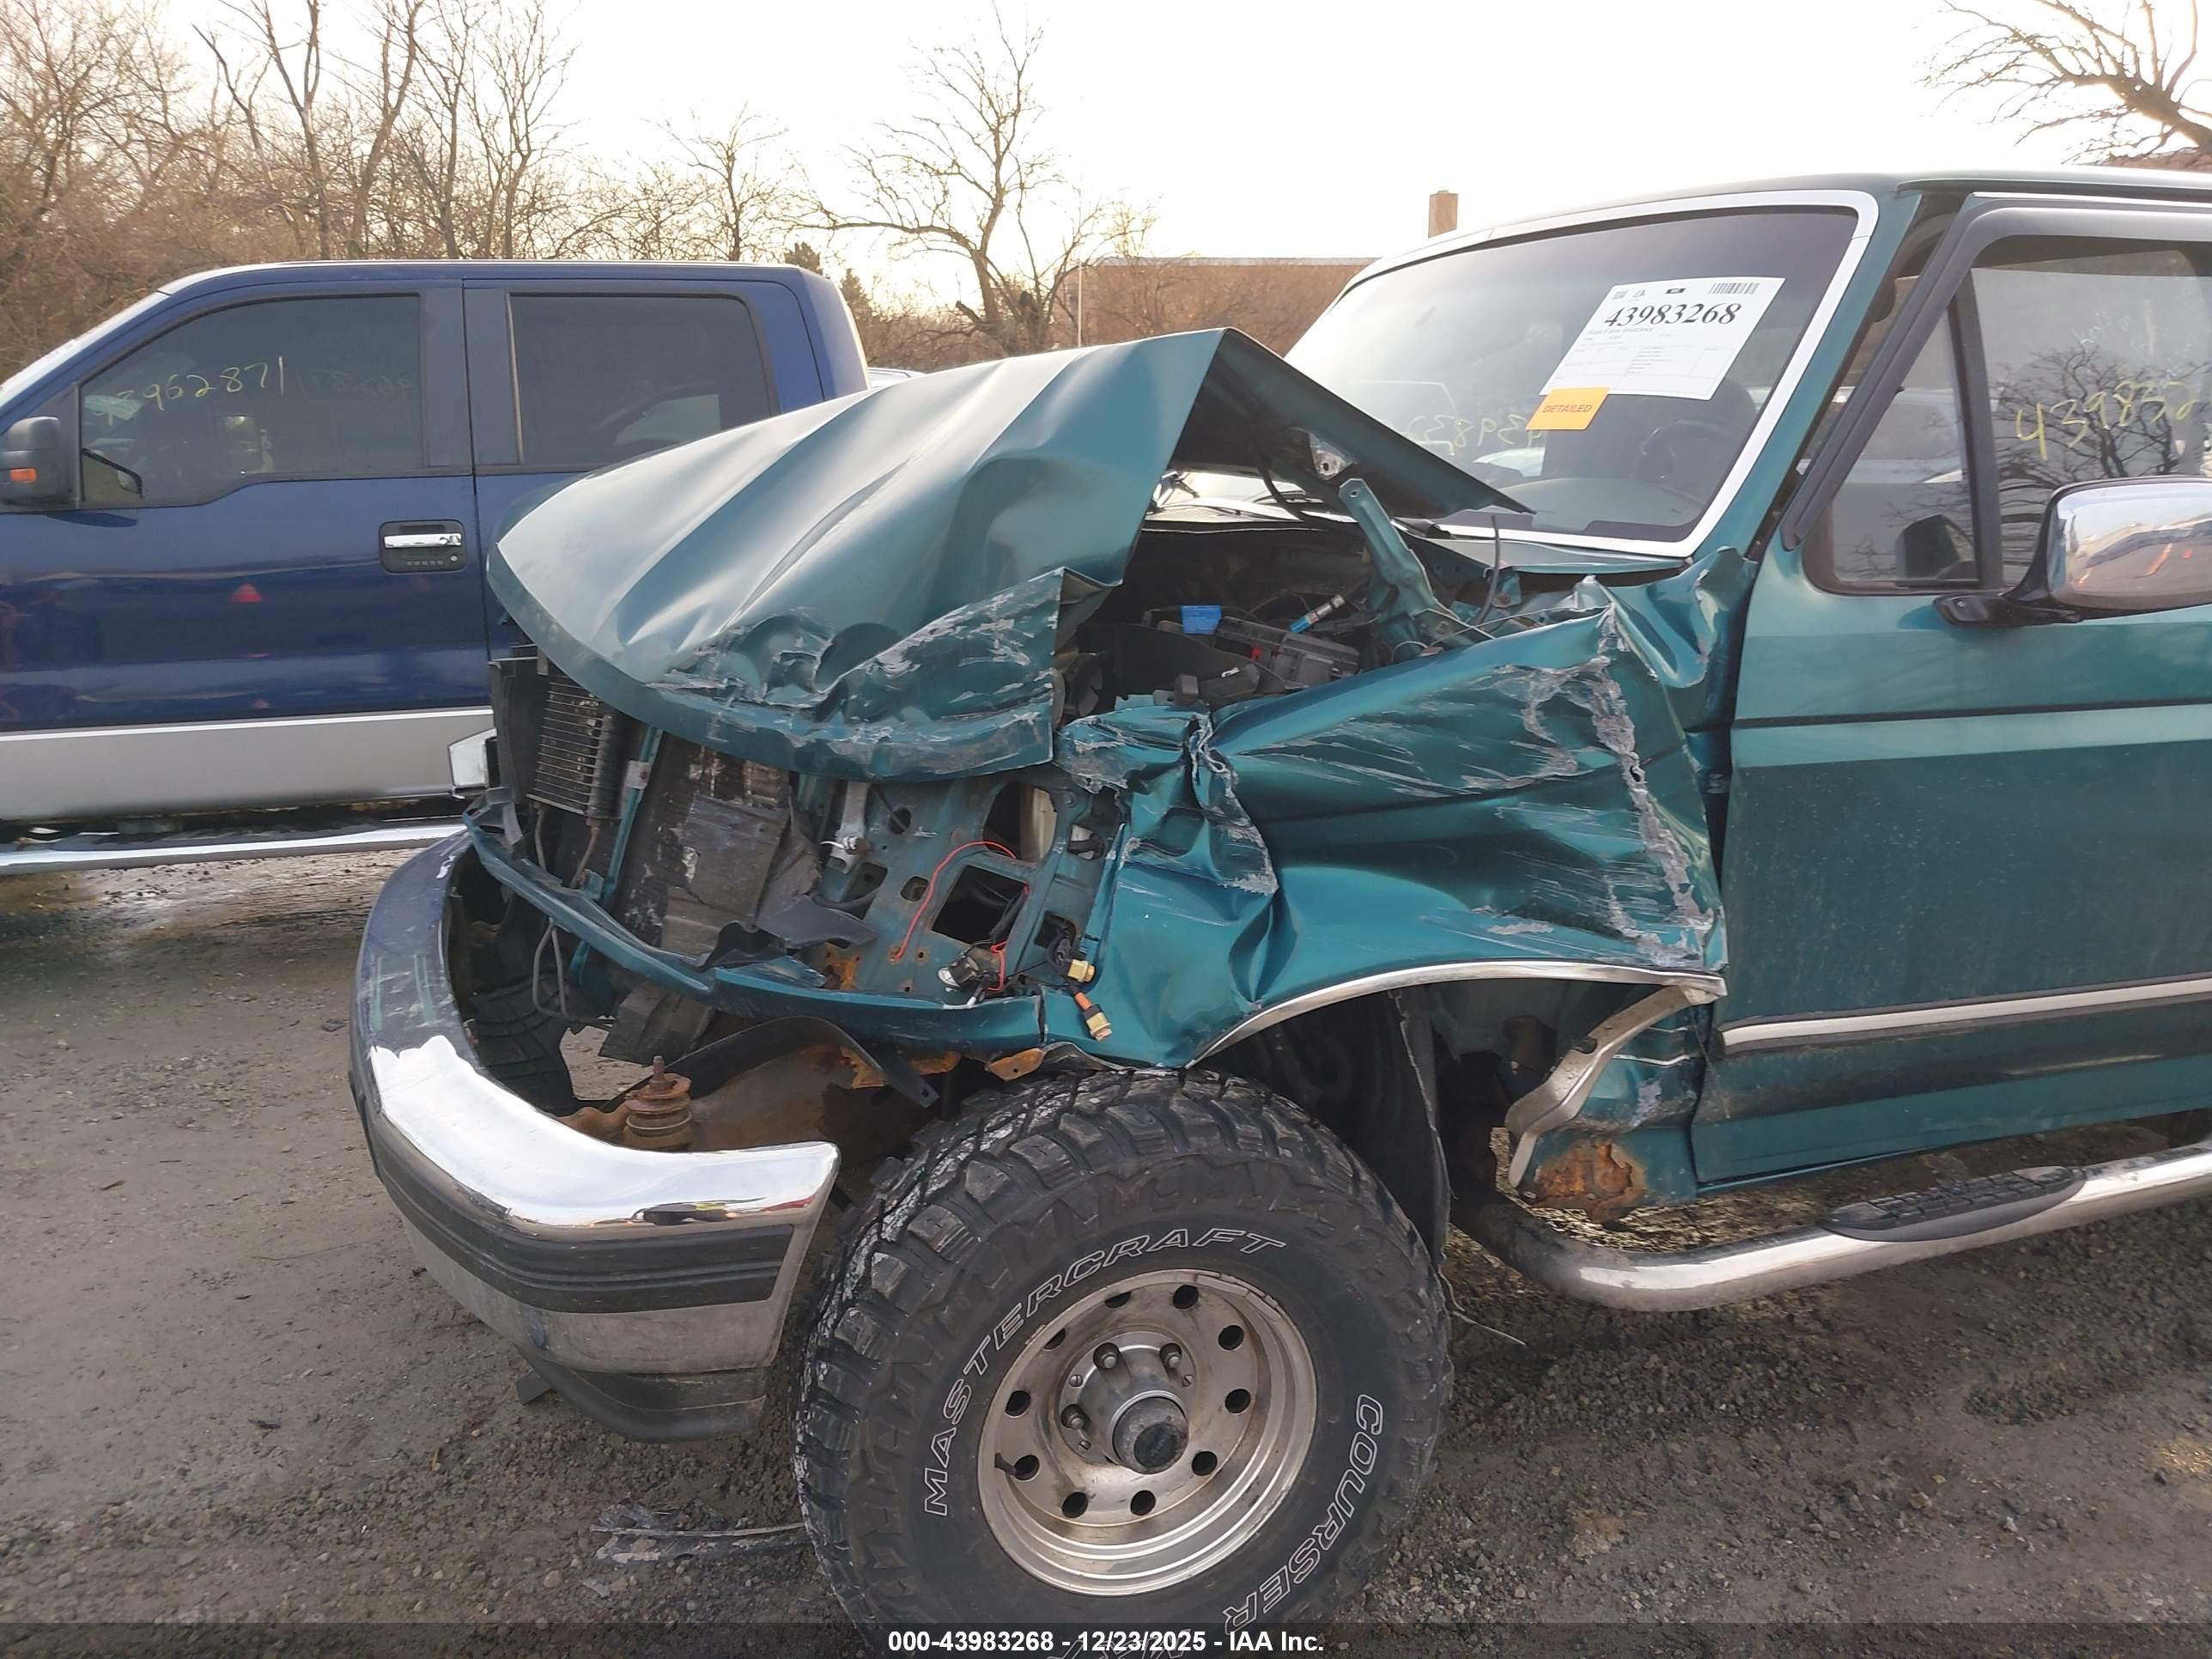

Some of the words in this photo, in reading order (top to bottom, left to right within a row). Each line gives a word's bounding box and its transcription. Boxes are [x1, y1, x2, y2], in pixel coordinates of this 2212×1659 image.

[1604, 303, 1741, 327] 43983268
[1542, 404, 1592, 414] DETAILED
[923, 1228, 1286, 1516] MASTERCRAFT
[1222, 1394, 1384, 1636] COURSER
